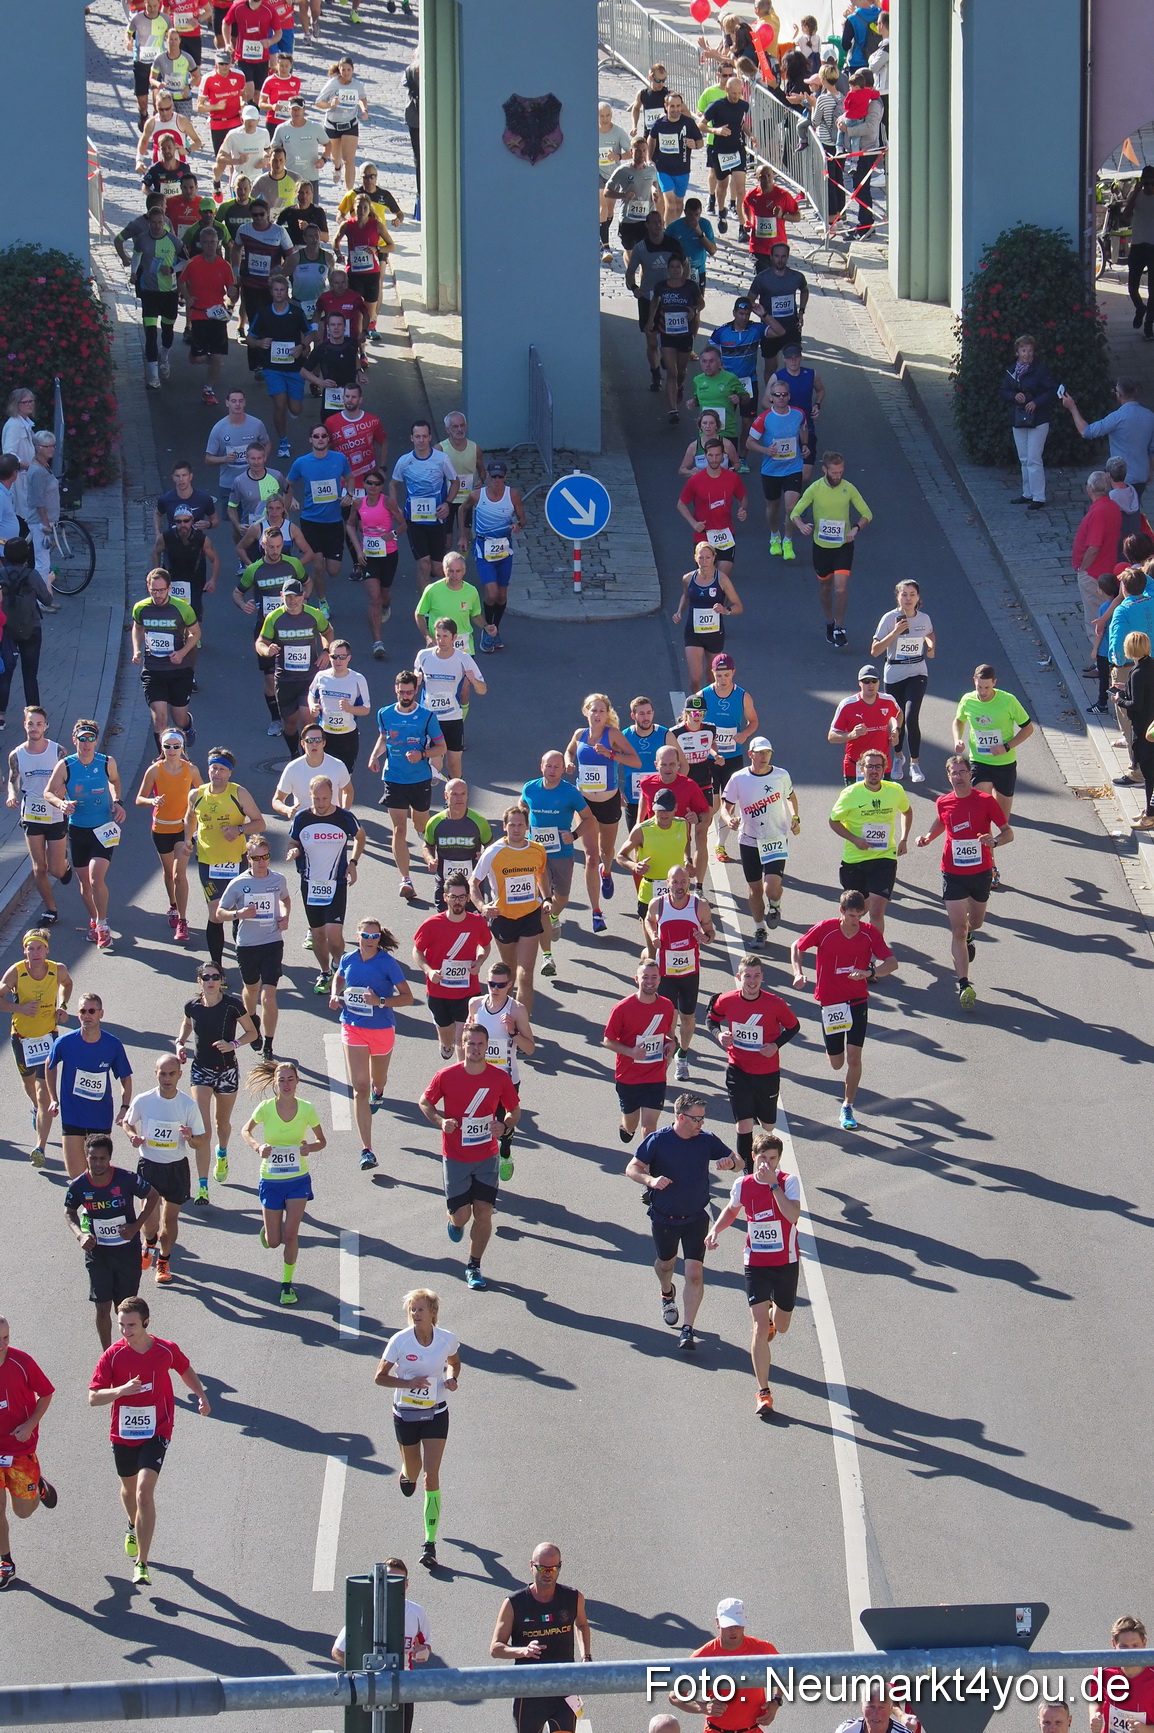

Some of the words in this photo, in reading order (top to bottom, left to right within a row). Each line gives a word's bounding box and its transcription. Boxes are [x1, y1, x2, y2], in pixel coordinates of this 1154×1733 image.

[251, 260, 268, 268] 2519
[775, 300, 791, 309] 2597
[668, 318, 684, 326] 2018
[276, 348, 290, 356] 310
[317, 486, 332, 494] 340
[416, 504, 430, 512] 211
[822, 526, 840, 534] 2353
[714, 534, 727, 542] 260
[366, 540, 380, 548] 206
[490, 544, 504, 552] 224
[172, 587, 184, 595] 309
[142, 619, 176, 628] BOCK
[278, 627, 314, 638] BOCK
[150, 640, 170, 648] 2528
[454, 639, 464, 648] 64
[900, 644, 918, 652] 2506
[288, 652, 306, 660] 2634
[431, 698, 450, 708] 2784
[328, 716, 344, 725] 232
[716, 734, 732, 743] 2077
[980, 736, 998, 744] 2175
[584, 772, 600, 781] 350
[32, 804, 46, 812] 236
[744, 792, 780, 815] FINISHER
[751, 806, 767, 818] 2017
[103, 828, 118, 838] 344
[866, 830, 886, 839] 2296
[438, 836, 476, 846] BOCK
[534, 834, 554, 843] 2609
[762, 841, 782, 852] 3072
[956, 846, 977, 856] 2465
[502, 866, 534, 875] Continental
[312, 886, 332, 894] 2598
[510, 882, 531, 893] 2246
[672, 957, 688, 966] 264
[446, 968, 466, 976] 2620
[348, 993, 366, 1003] 255
[828, 1012, 844, 1022] 262
[736, 1030, 758, 1040] 2619
[28, 1042, 50, 1054] 3119
[80, 1077, 102, 1090] 2635
[154, 1128, 172, 1138] 247
[467, 1123, 489, 1134] 2614
[272, 1152, 296, 1164] 2616
[84, 1198, 126, 1210] MENSCH
[754, 1229, 778, 1240] 2459
[410, 1385, 428, 1396] 273
[124, 1415, 150, 1426] 2455
[522, 1625, 572, 1638] PODIUMPACE
